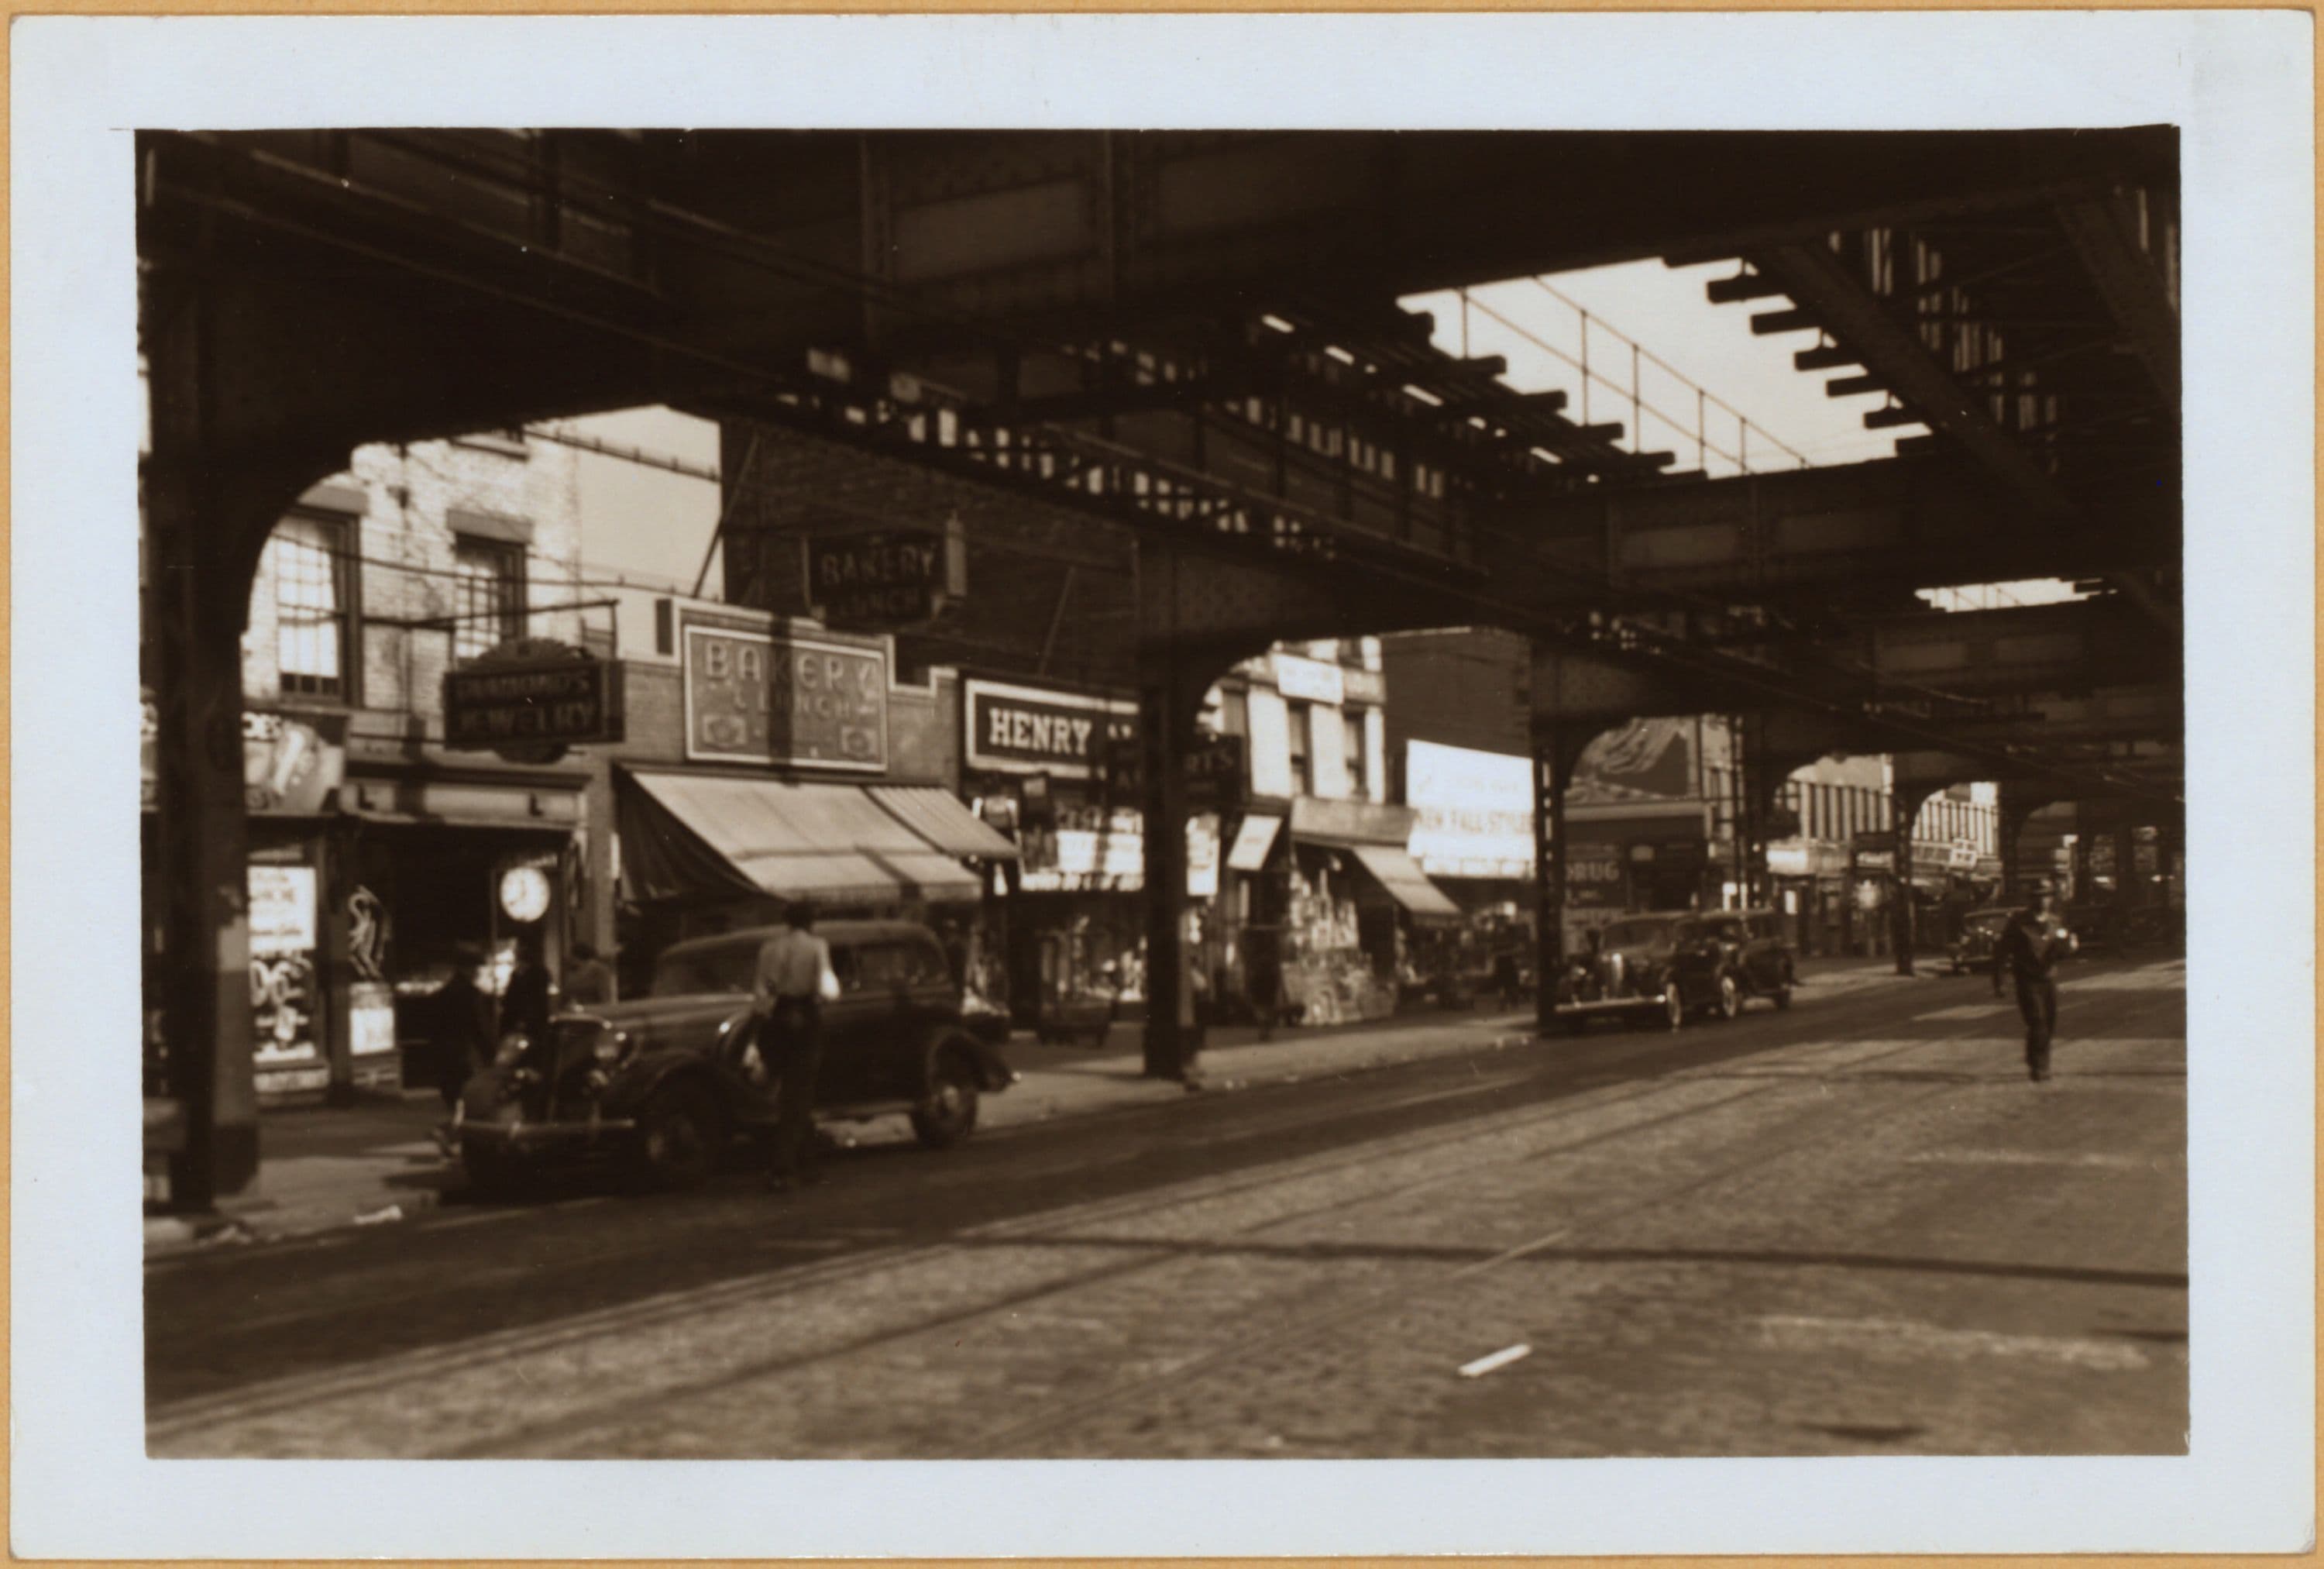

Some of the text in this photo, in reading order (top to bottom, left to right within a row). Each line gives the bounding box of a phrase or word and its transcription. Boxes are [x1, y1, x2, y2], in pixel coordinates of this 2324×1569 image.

[820, 542, 938, 585] BAKERY
[704, 639, 879, 702] BAKERY
[988, 707, 1092, 756] HENRY
